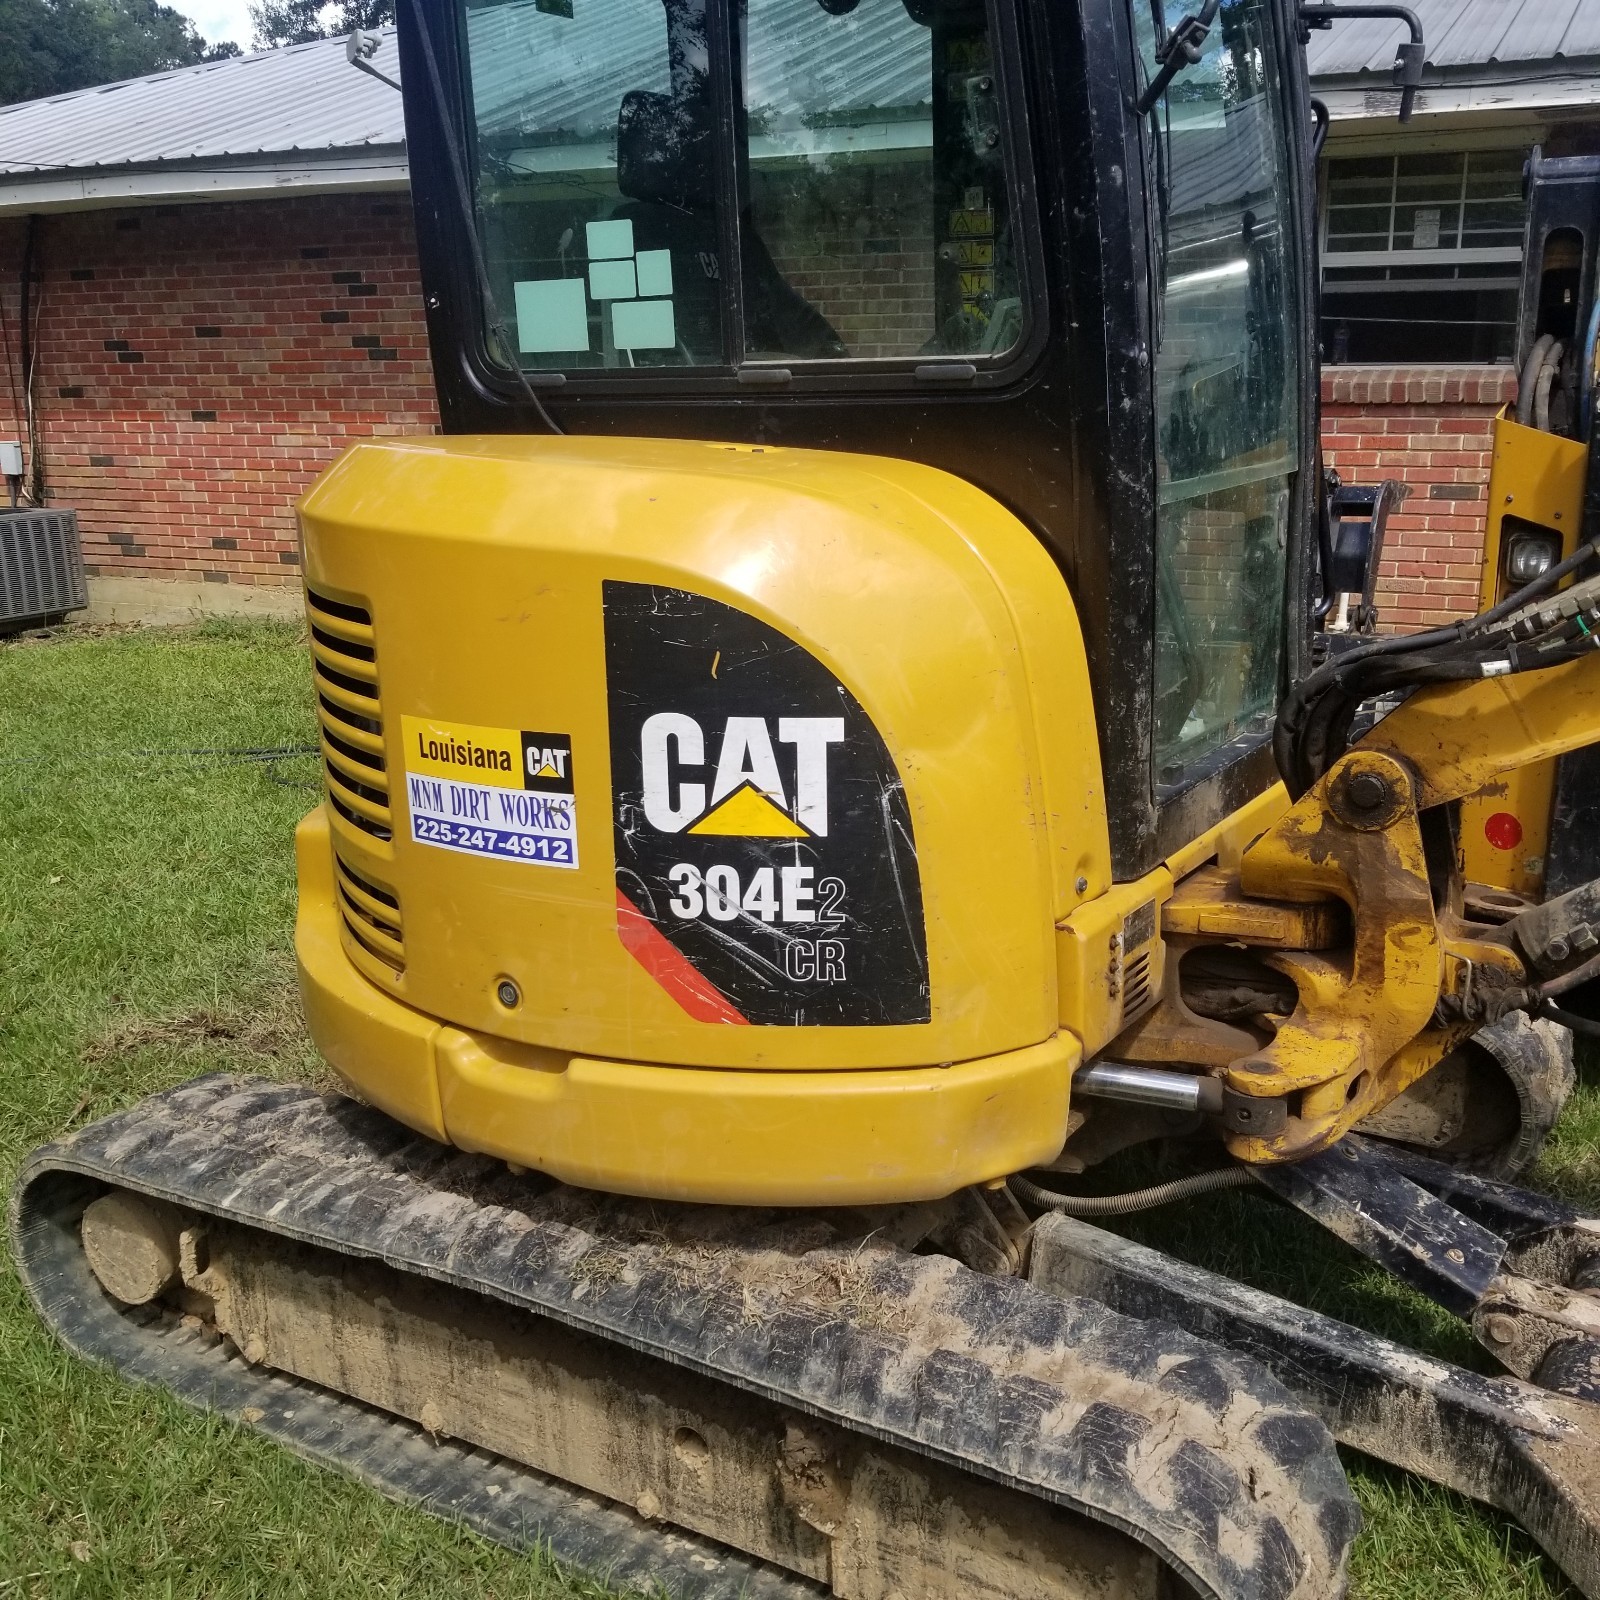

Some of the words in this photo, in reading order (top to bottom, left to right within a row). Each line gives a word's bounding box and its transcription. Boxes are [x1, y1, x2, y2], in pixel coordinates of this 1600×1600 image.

[698, 251, 719, 279] CA
[418, 732, 513, 772] Louisiana
[526, 746, 568, 778] CAT
[641, 712, 845, 837] CAT
[409, 777, 445, 813] MNM
[449, 785, 492, 823] DIRT
[498, 792, 572, 832] WORKS
[416, 818, 569, 860] 225-247-4912
[785, 938, 847, 981] CR
